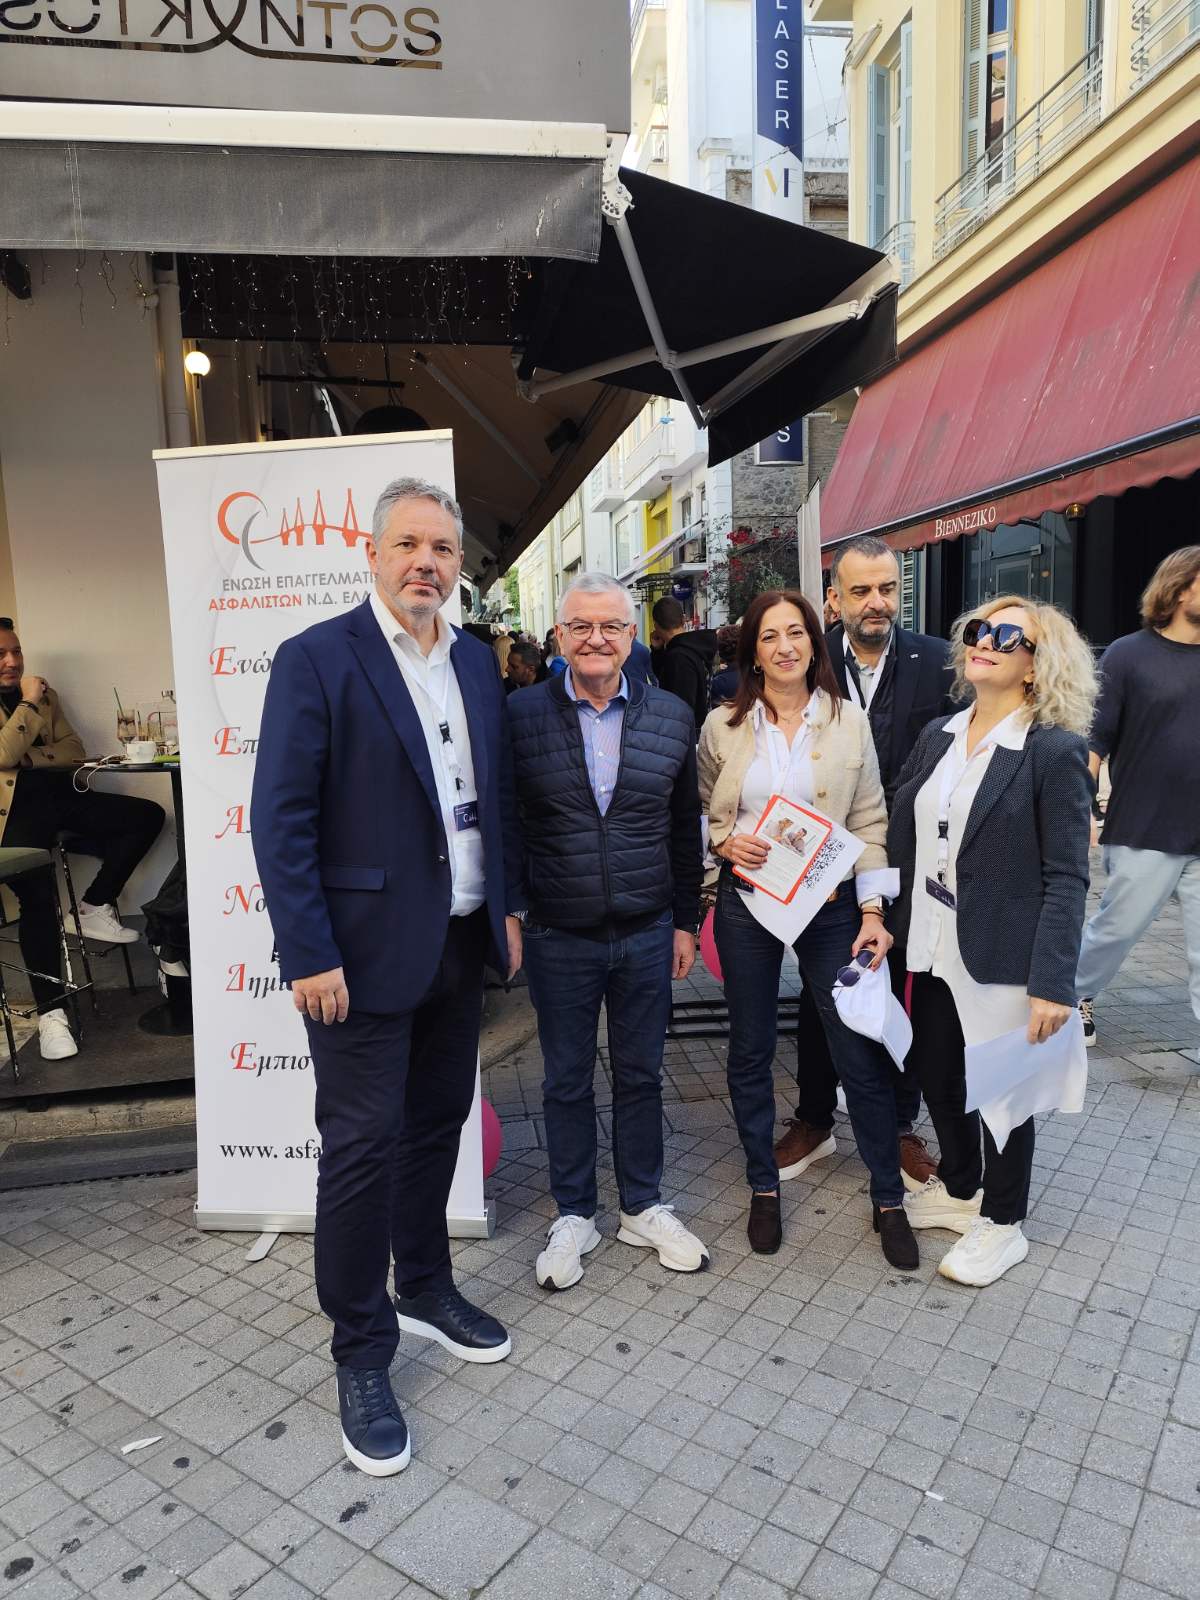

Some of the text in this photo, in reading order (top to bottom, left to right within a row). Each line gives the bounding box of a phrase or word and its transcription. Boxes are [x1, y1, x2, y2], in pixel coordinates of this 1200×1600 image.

[774, 0, 790, 129] LASER
[222, 571, 377, 592] ΕΝΩΣΗ ΕΠΑΓΓΕΛΜΑΤΙ
[208, 594, 302, 611] ΑΣΦΑΛΙΣΤΩΝ
[307, 592, 337, 606] Ν.Δ.
[209, 646, 272, 675] Ενώ
[214, 804, 252, 839] Α
[225, 963, 293, 999] Δημι
[230, 1042, 311, 1077] Εμπισ
[219, 1143, 278, 1159] www.
